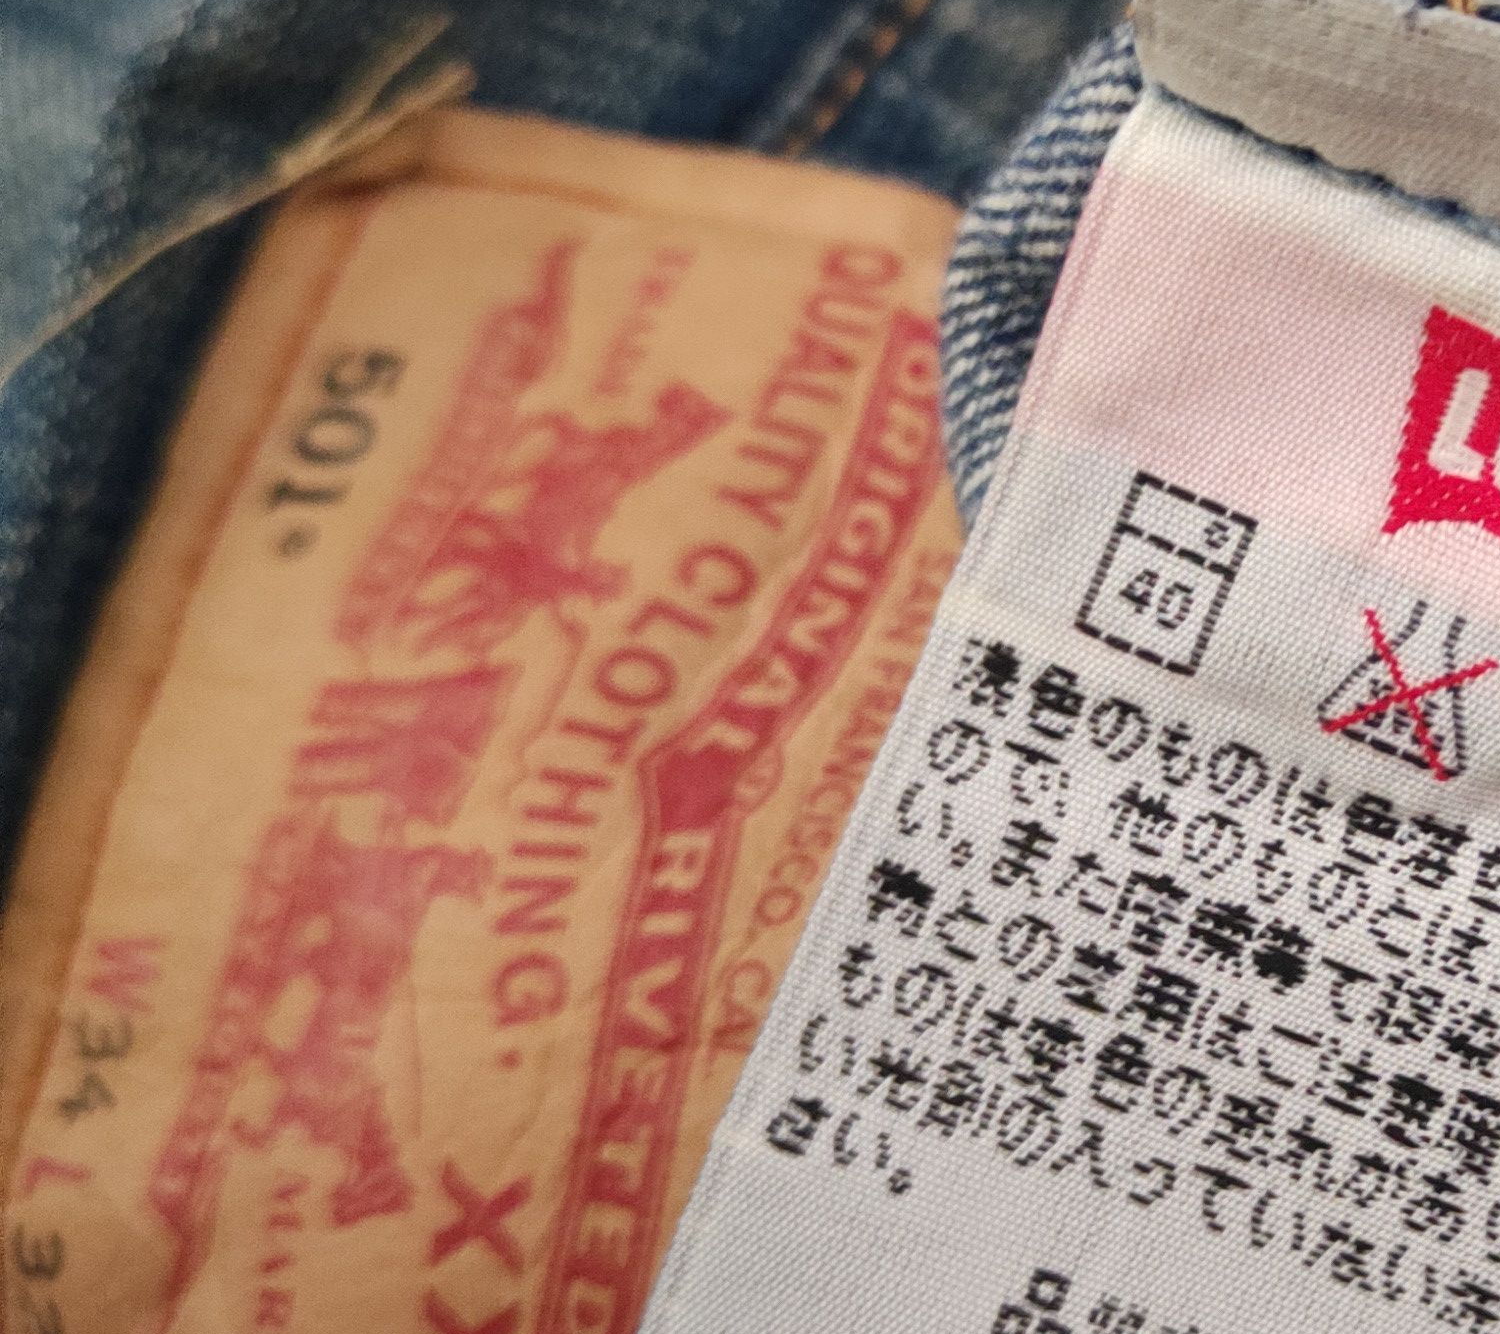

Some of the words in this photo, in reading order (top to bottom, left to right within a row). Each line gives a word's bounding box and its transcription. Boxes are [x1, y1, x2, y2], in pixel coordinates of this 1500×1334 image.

[711, 244, 905, 529] QUALITY
[694, 347, 940, 754] ORIGINAL
[1119, 569, 1192, 630] 40
